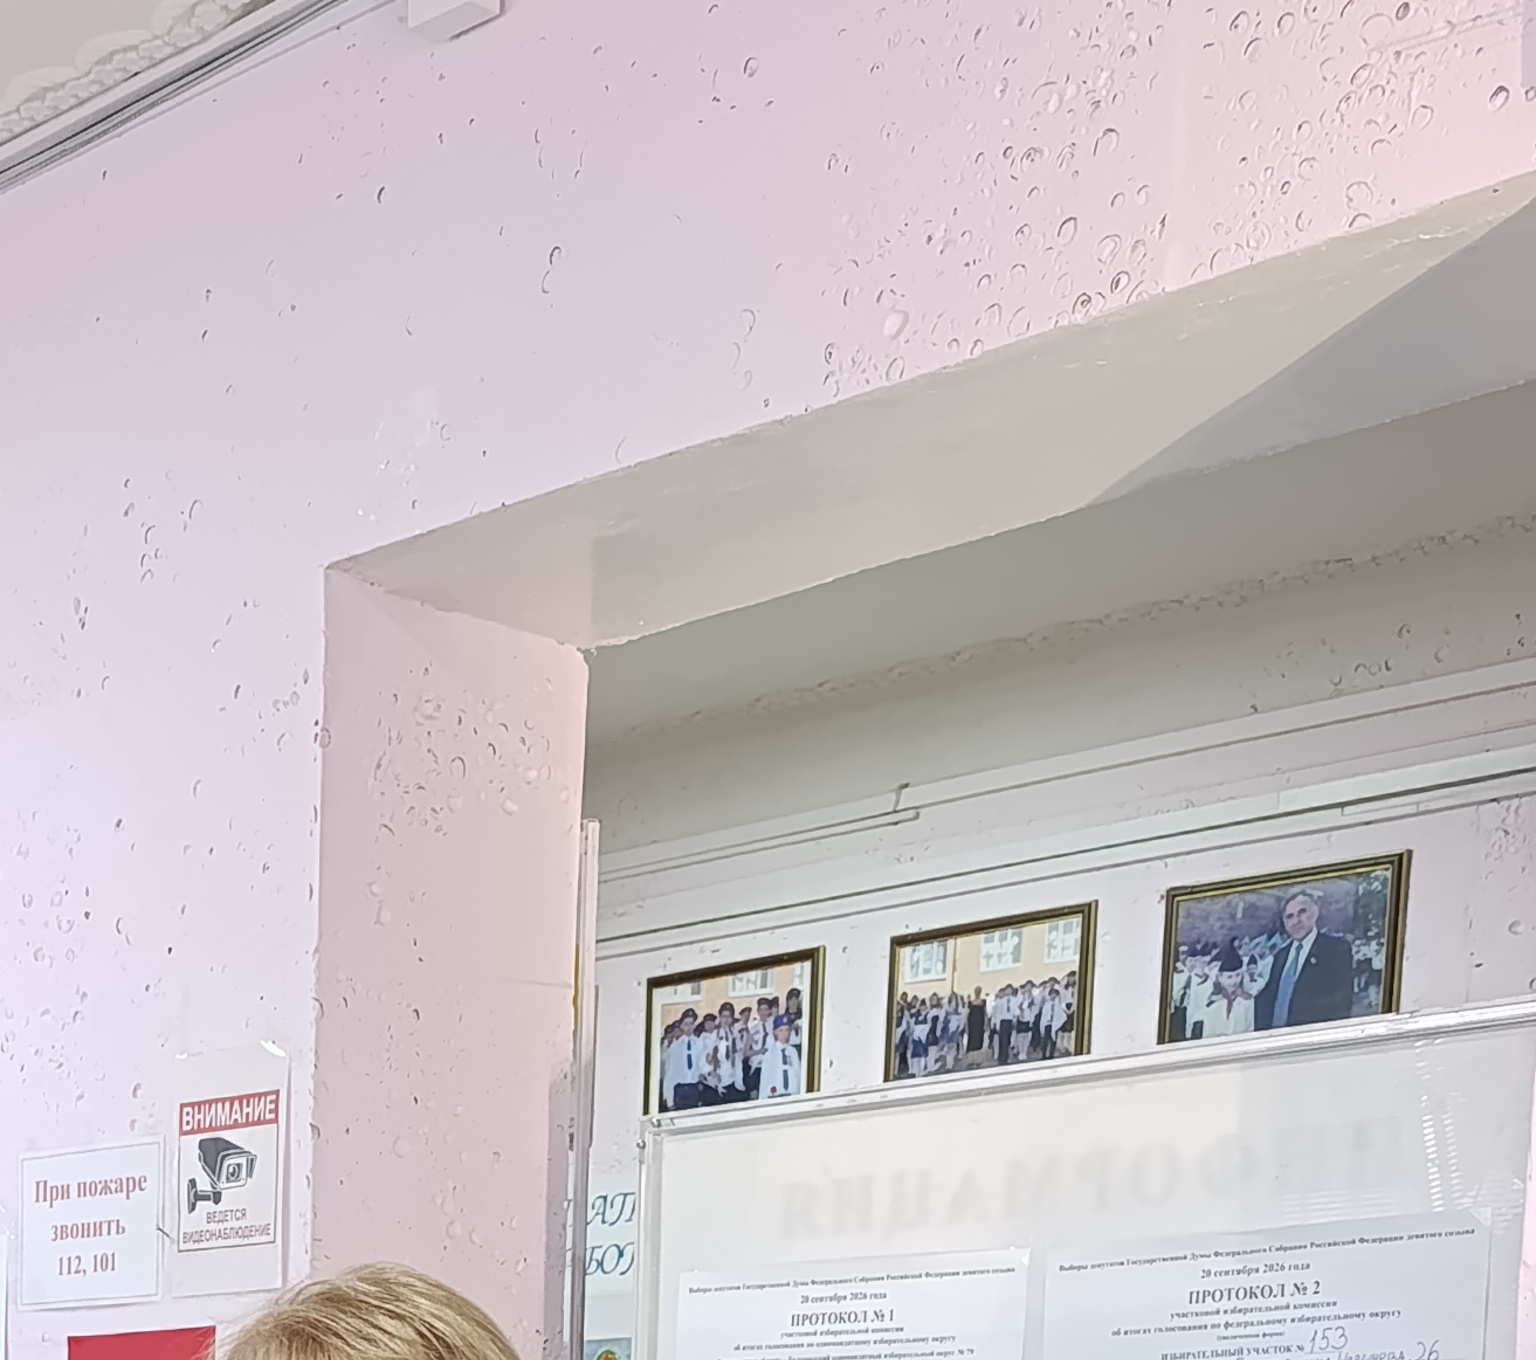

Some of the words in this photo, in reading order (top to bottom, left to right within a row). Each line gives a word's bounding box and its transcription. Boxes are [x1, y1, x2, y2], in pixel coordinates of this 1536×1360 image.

[182, 1094, 276, 1131] ВНИМАНИЕ
[35, 1179, 71, 1208] При
[77, 1174, 148, 1201] пожаре
[206, 1208, 247, 1225] ВЕДЕТСЯ
[50, 1218, 126, 1242] звонить
[182, 1223, 271, 1245] ВИДЕОНАБЛЮДЕНИЕ
[57, 1255, 87, 1277] 112,
[92, 1252, 116, 1273] 101
[1200, 1269, 1212, 1279] 20
[1213, 1265, 1260, 1278] сентября
[1262, 1263, 1286, 1274] 2026
[1287, 1262, 1311, 1272] года
[800, 1295, 809, 1305] 20
[1188, 1283, 1285, 1305] ПРОТОКОЛ
[1290, 1282, 1309, 1297] №
[1312, 1280, 1321, 1294] 2
[791, 1310, 868, 1327] ПРОТОКОЛ
[870, 1309, 886, 1323] №
[889, 1308, 895, 1322] 1
[1246, 1344, 1293, 1357] УЧАСТОК
[1308, 1326, 1349, 1355] 153
